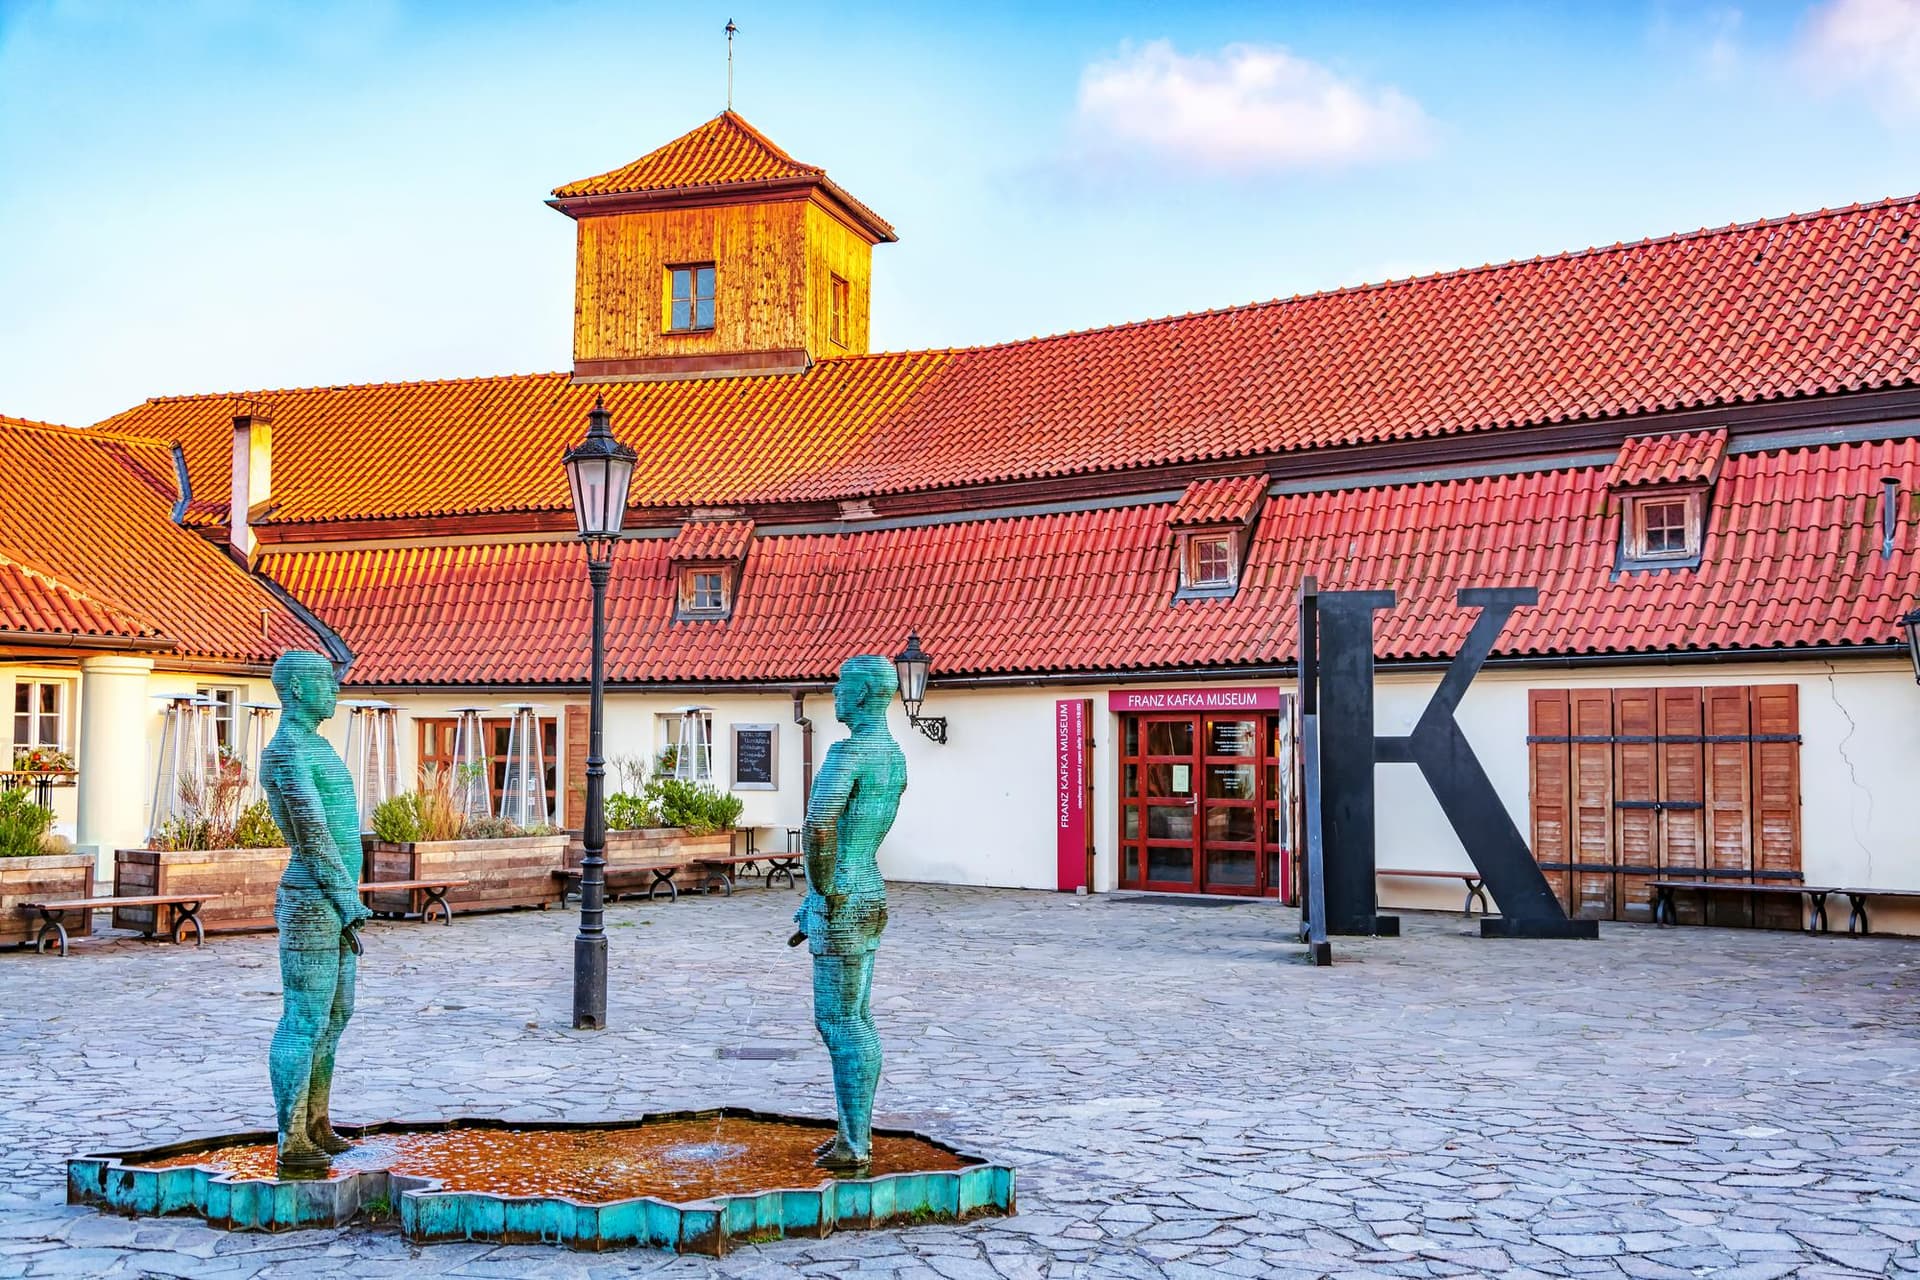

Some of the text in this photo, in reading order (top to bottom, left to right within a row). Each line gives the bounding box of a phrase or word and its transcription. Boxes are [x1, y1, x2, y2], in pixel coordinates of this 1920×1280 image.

[1128, 692, 1258, 707] FRANZ KAFKA MUSEUM
[1059, 704, 1069, 828] FRANZ KAFKA MUSEUM
[1317, 587, 1599, 939] K
